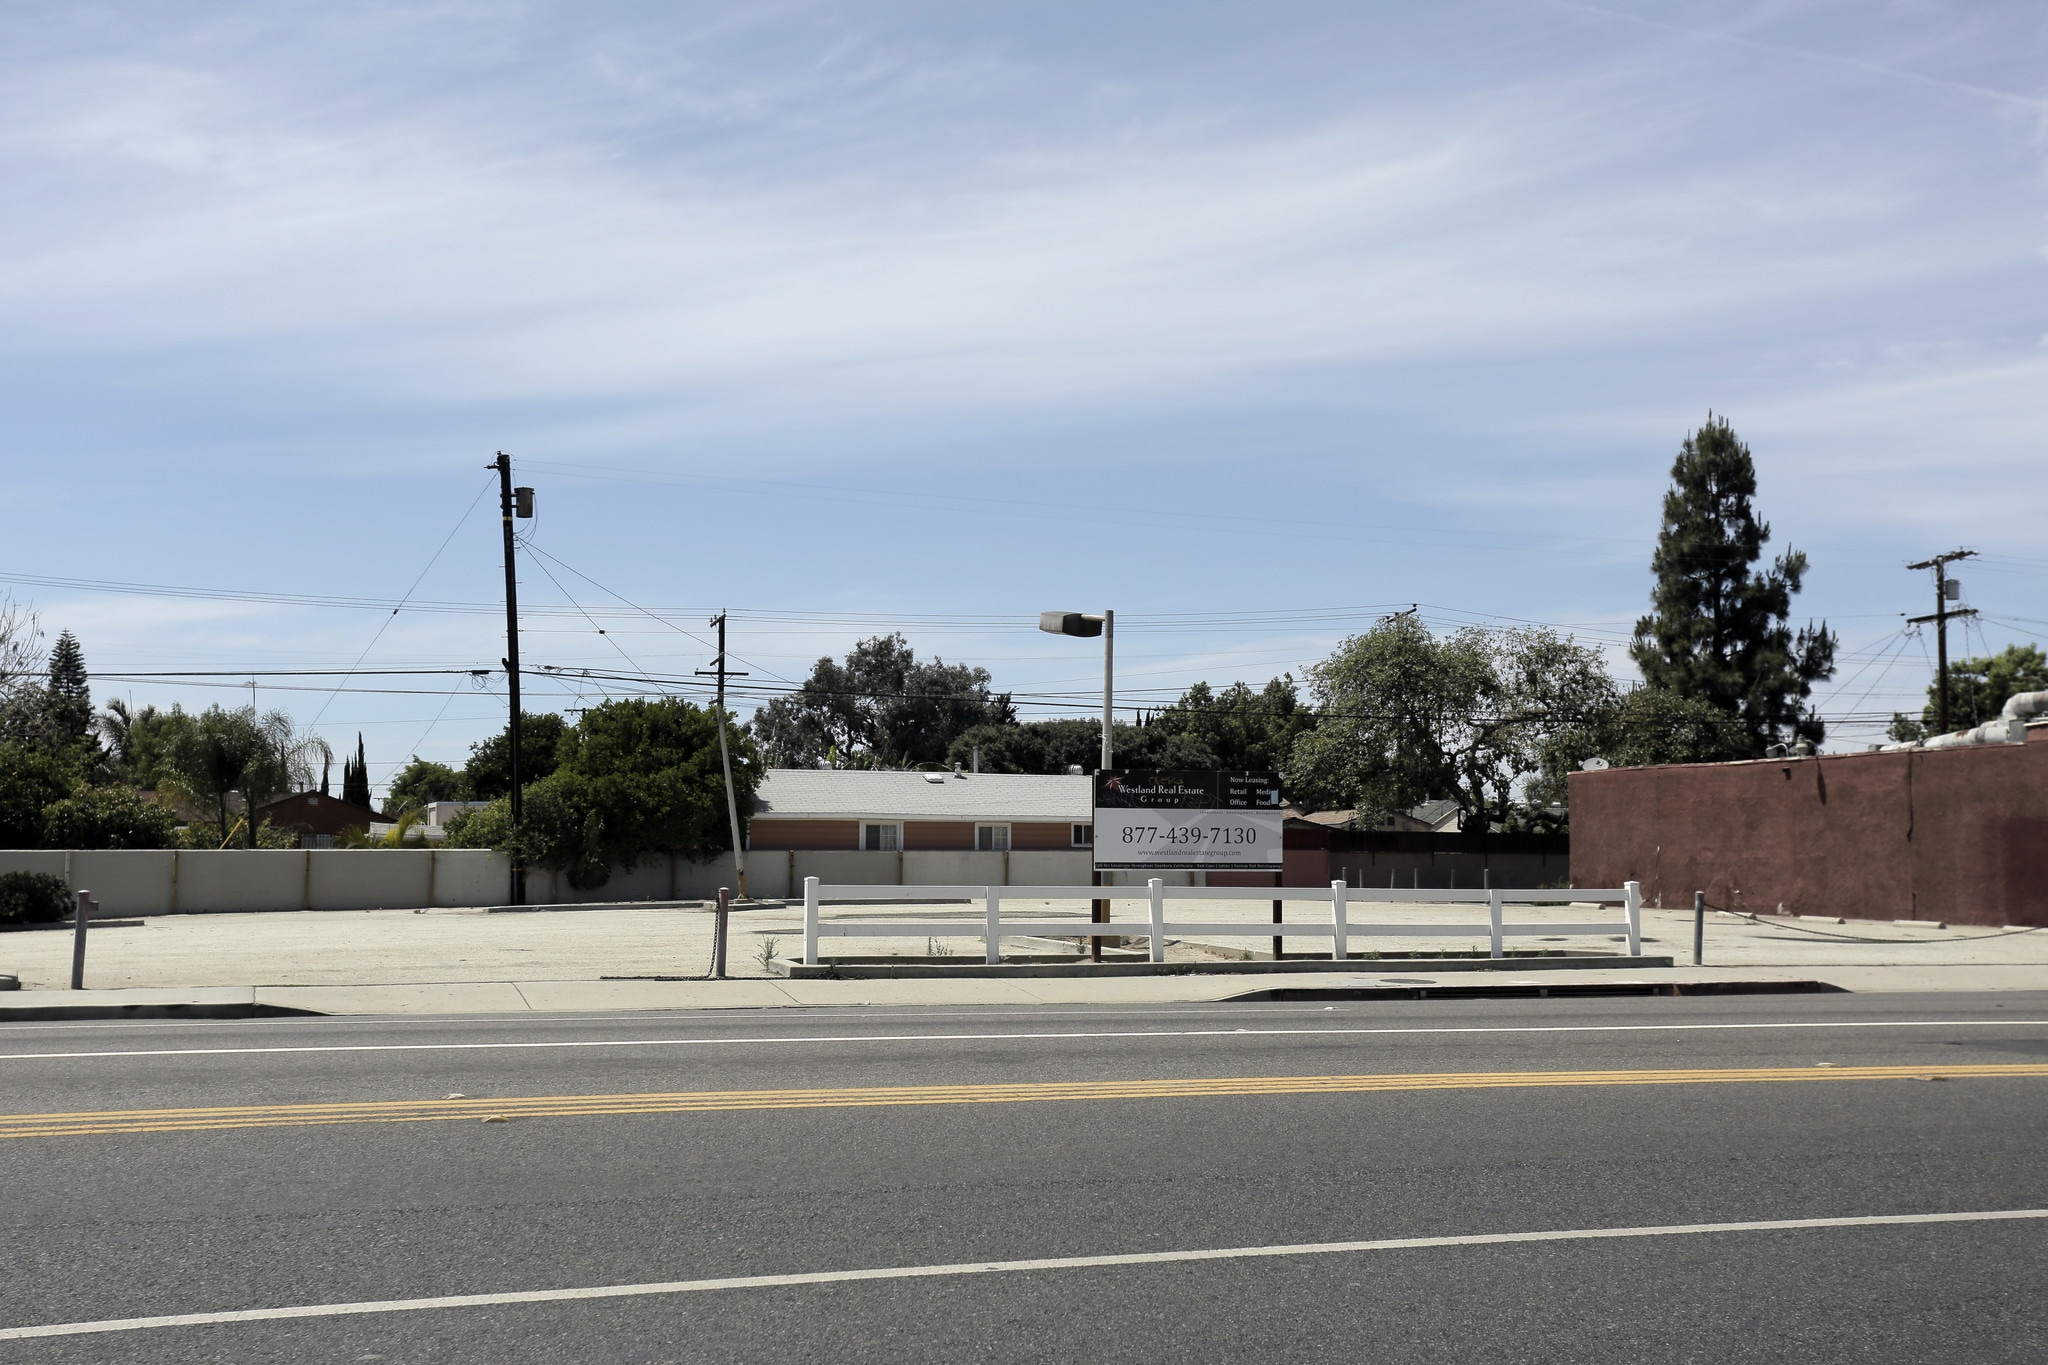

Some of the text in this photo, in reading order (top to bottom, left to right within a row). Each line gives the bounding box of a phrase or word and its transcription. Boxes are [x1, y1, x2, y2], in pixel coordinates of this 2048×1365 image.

[1245, 776, 1269, 785] Leasing:
[1118, 785, 1204, 795] Westland Real Estate
[1140, 795, 1179, 804] Group
[1122, 826, 1256, 844] 877-439-7130
[1137, 849, 1241, 857] www.westlandrealestategroup.com
